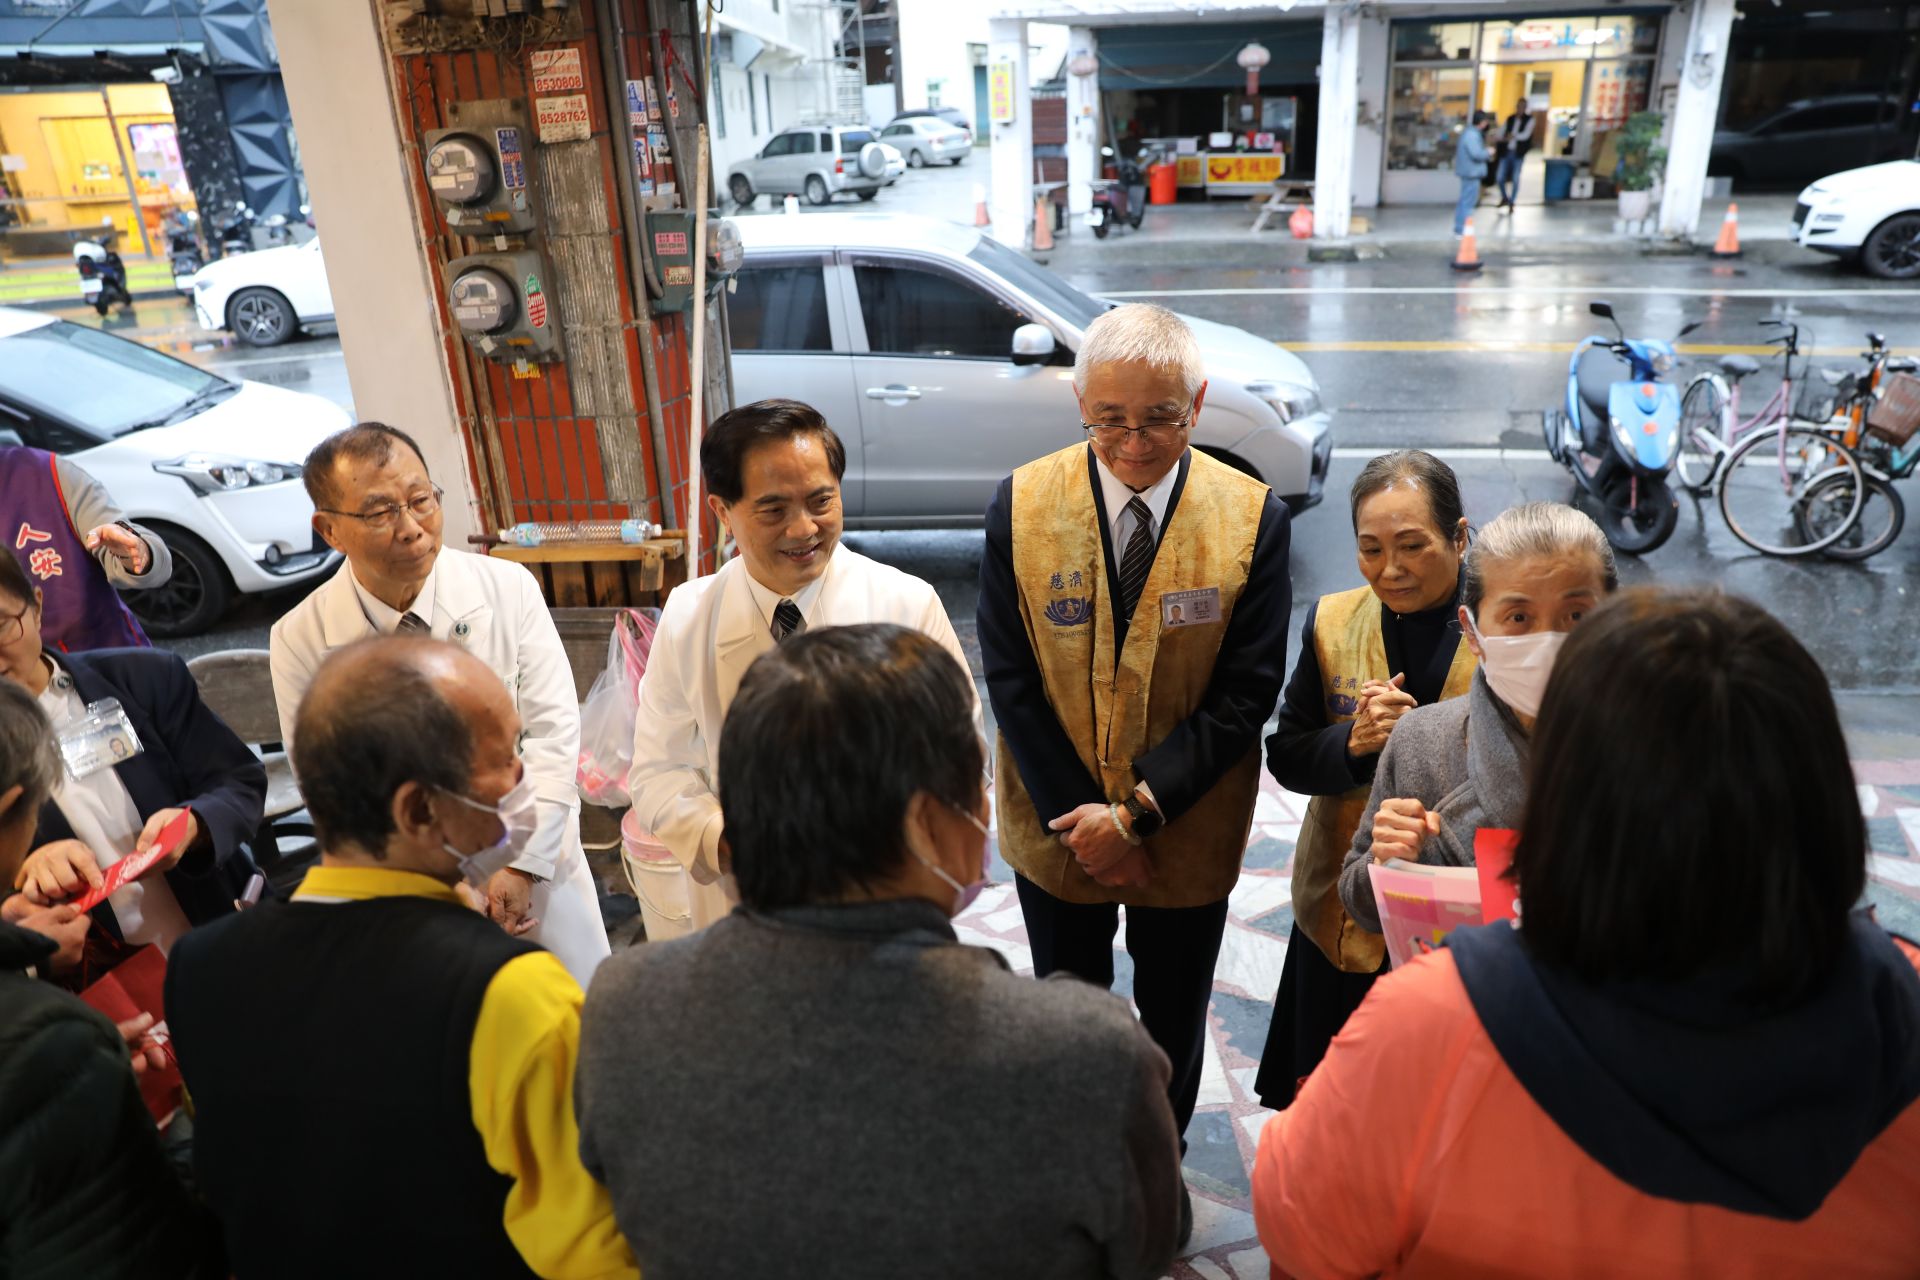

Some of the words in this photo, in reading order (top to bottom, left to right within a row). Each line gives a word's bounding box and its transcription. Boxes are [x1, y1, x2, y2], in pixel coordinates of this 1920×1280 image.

[536, 76, 582, 91] 8530808
[540, 111, 587, 125] 8528762
[1050, 570, 1083, 590] 慈濟
[1331, 674, 1358, 690] 慈濟
